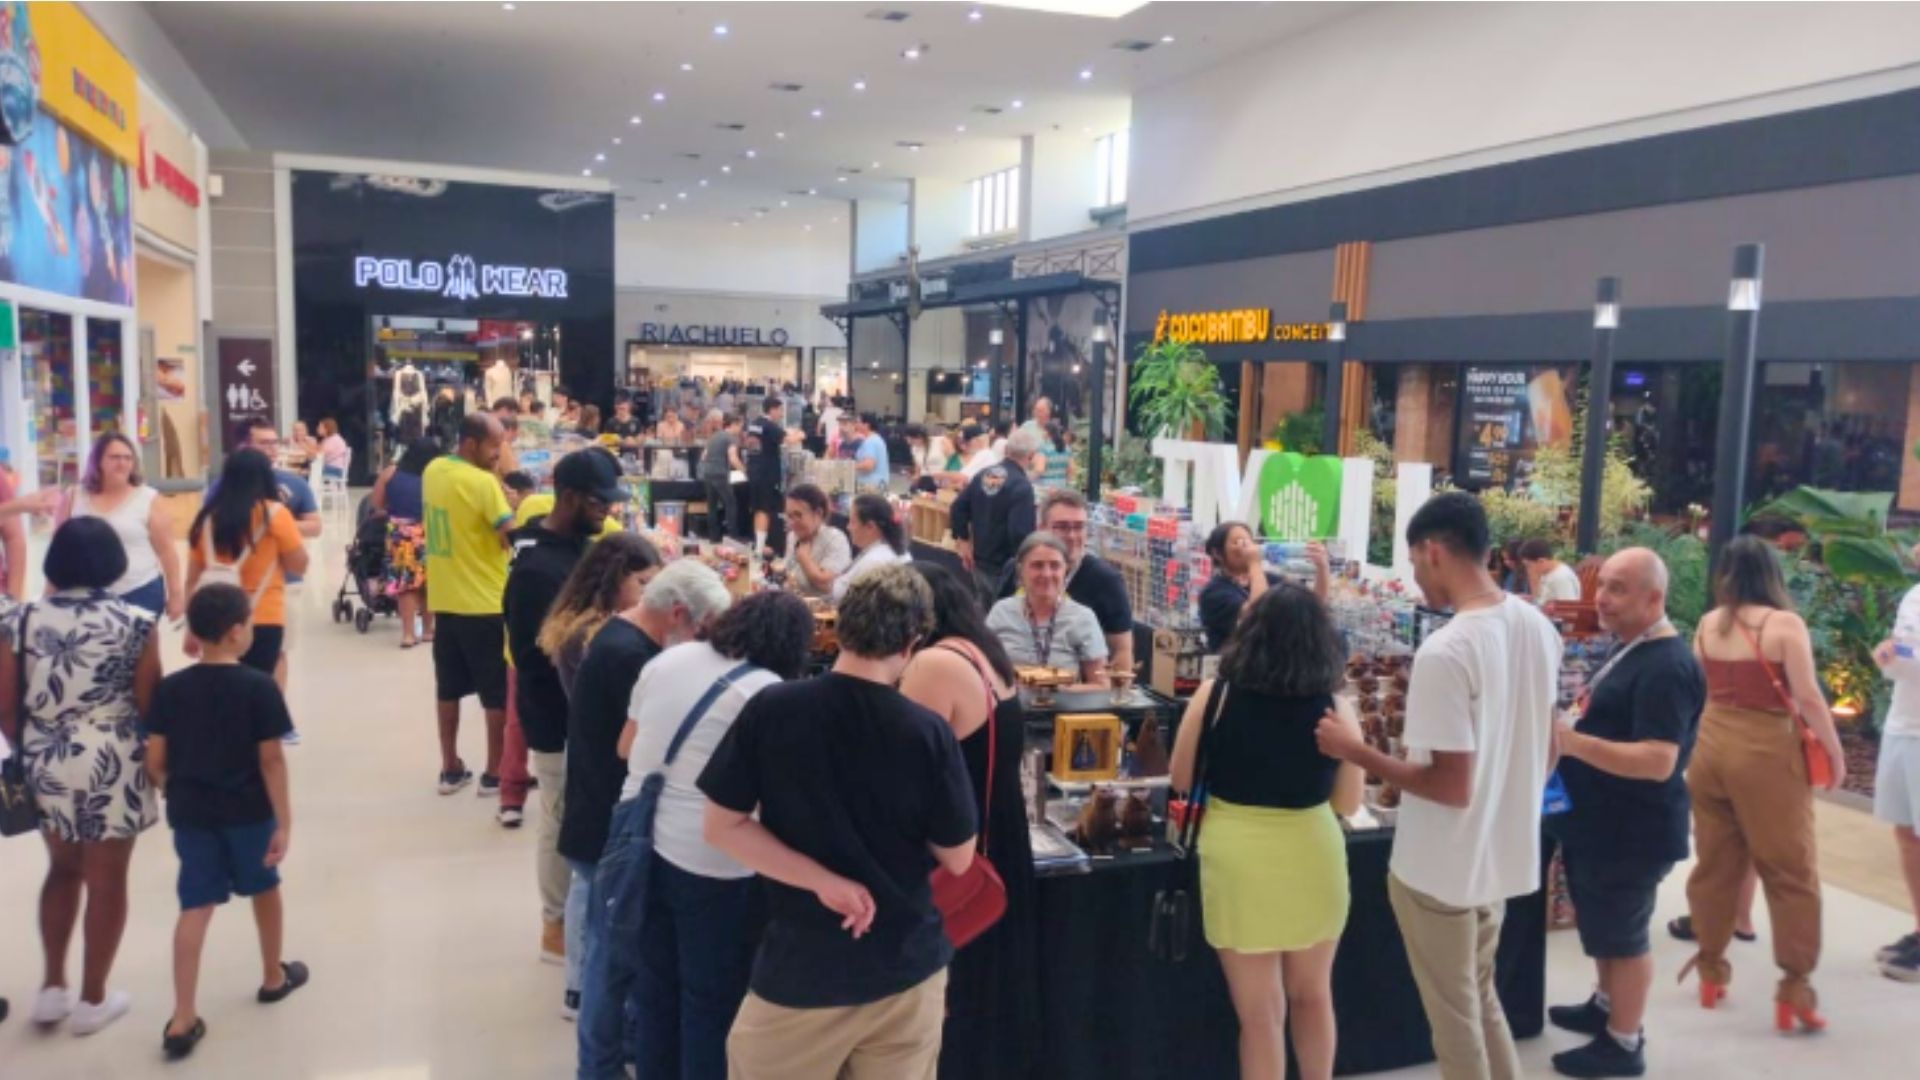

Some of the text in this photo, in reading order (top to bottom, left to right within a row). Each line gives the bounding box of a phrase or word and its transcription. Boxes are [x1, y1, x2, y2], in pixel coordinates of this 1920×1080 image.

[355, 256, 568, 297] POLO WEAR
[641, 322, 789, 346] RIACHUELO
[1168, 308, 1270, 344] COCOBAMBU
